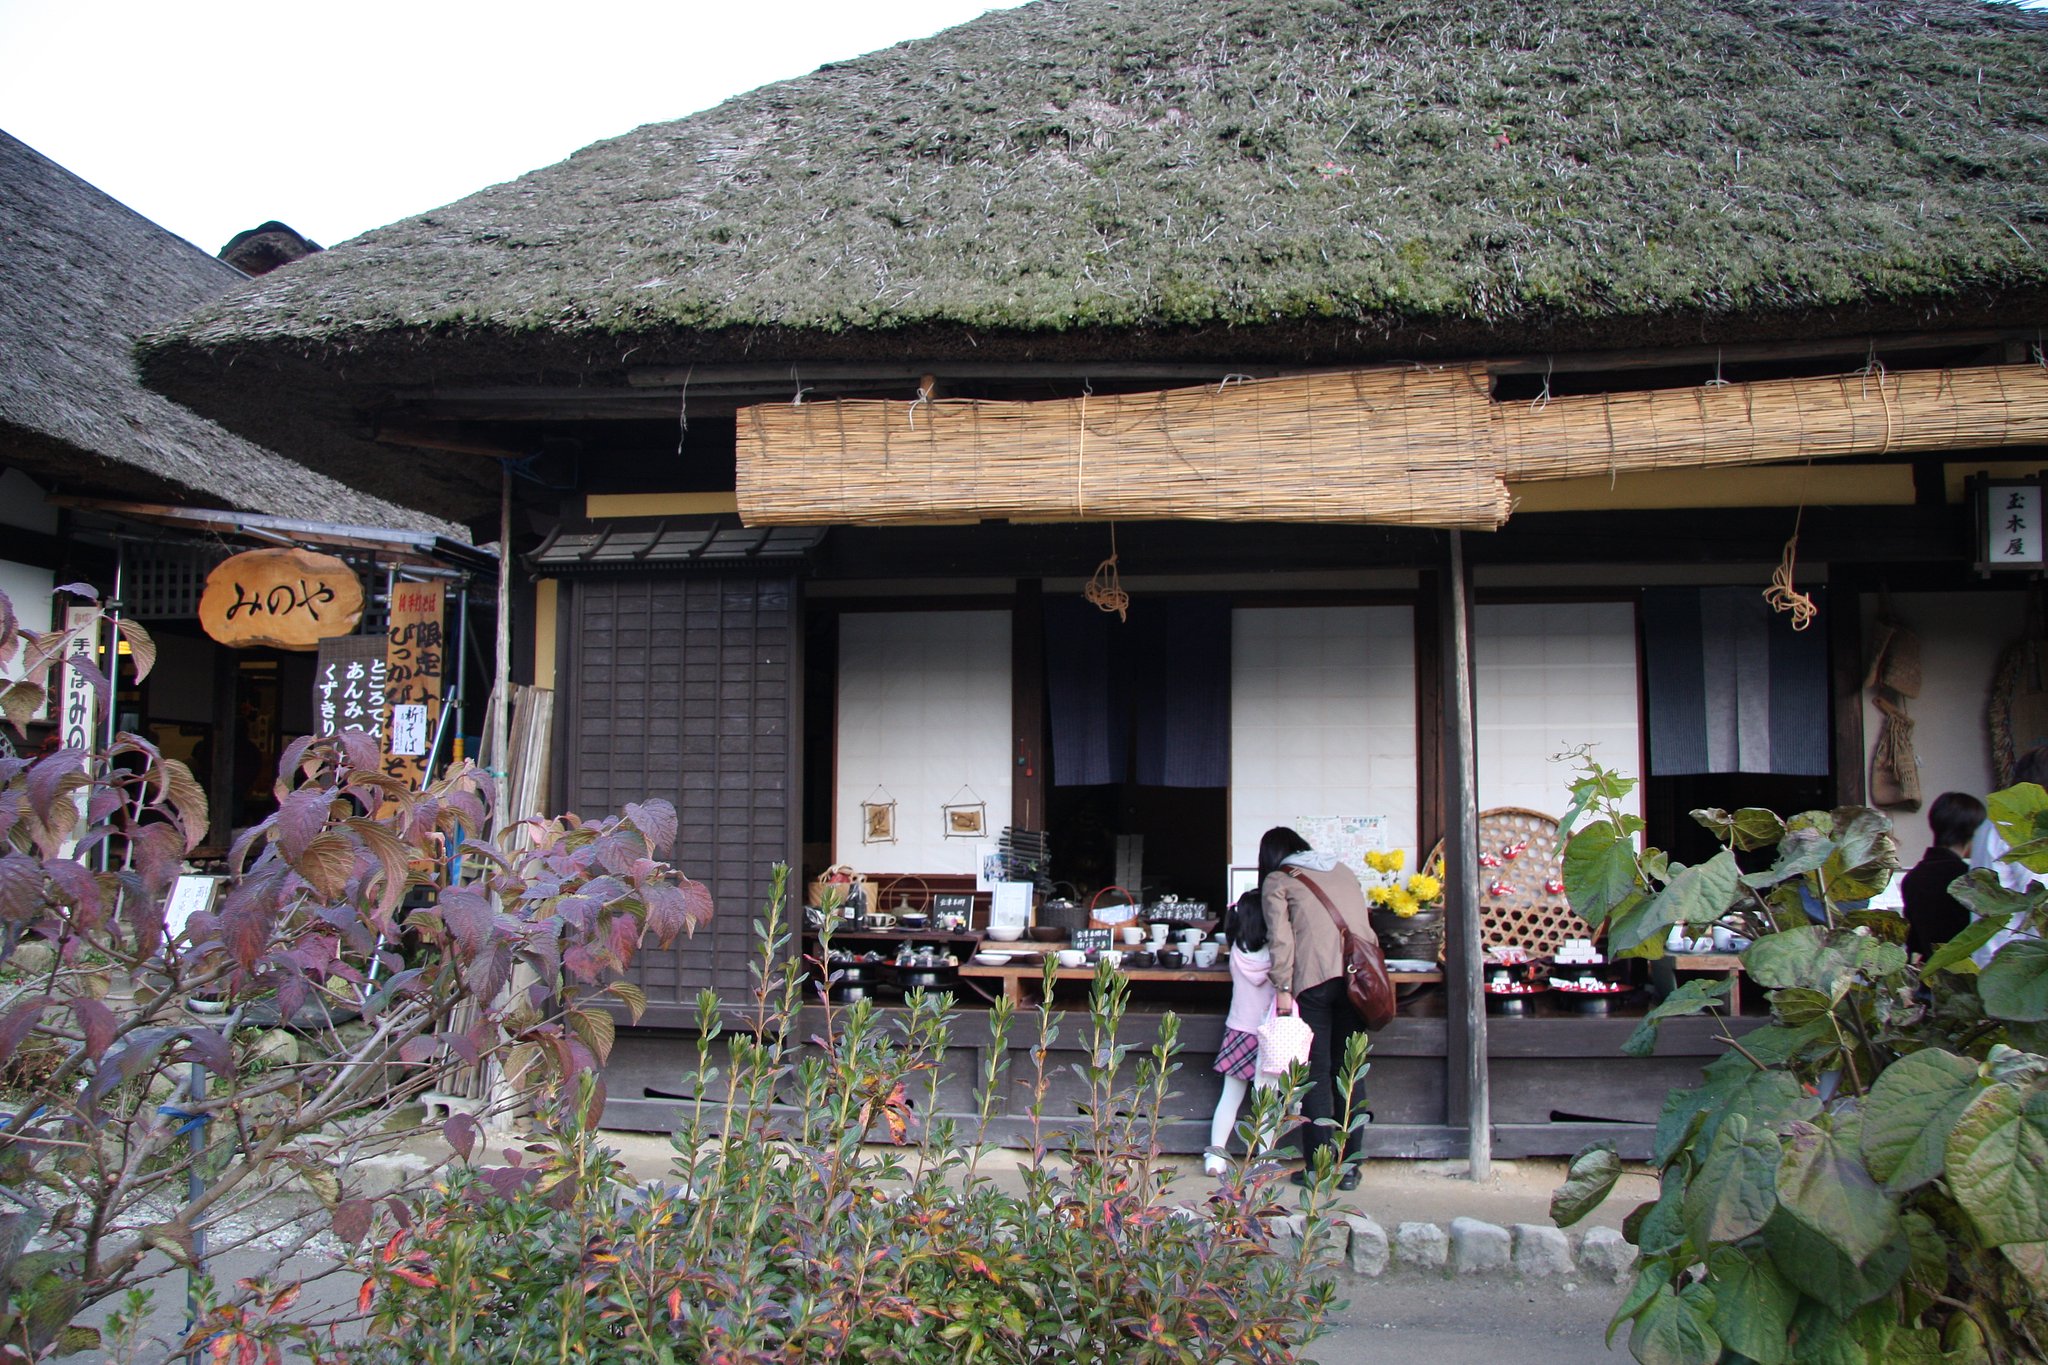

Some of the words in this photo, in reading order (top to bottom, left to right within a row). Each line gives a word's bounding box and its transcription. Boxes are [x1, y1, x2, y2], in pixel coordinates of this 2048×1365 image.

[2004, 492, 2027, 556] 玉木屋
[226, 579, 335, 621] みのや
[319, 663, 339, 738] くずきり
[343, 662, 365, 732] あんみつ
[367, 659, 387, 738] ところてん
[403, 706, 419, 753] 新そば
